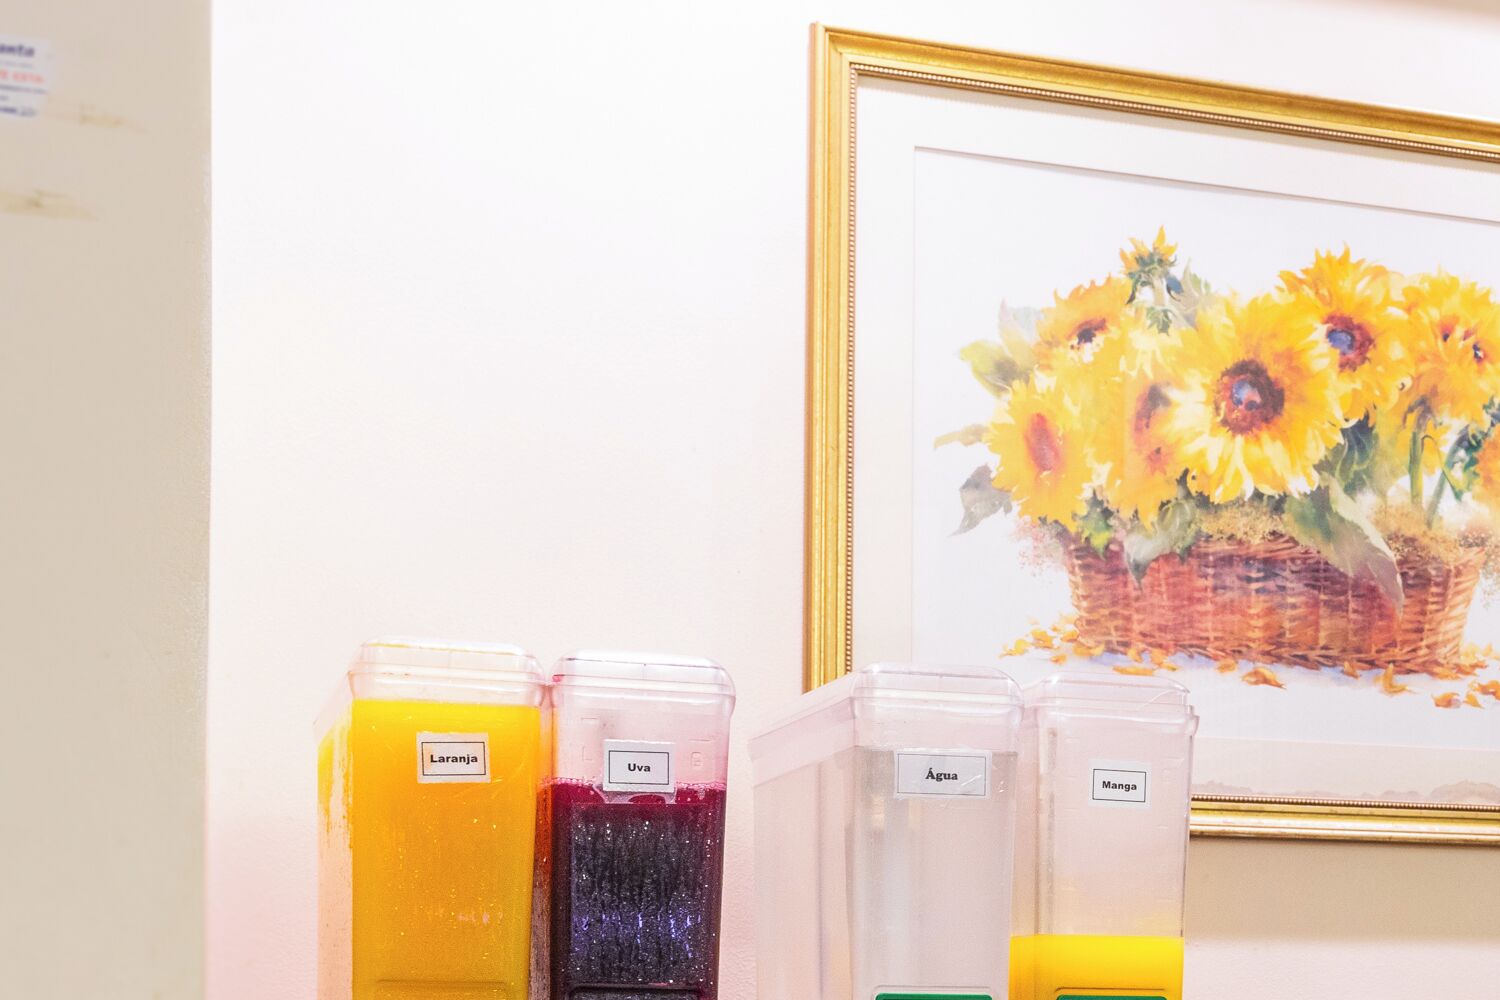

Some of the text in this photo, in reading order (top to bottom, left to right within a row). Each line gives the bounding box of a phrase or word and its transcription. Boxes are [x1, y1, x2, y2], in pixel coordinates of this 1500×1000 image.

[429, 754, 478, 766] Laranja
[627, 762, 651, 773] Uva
[925, 767, 958, 782] Água
[1101, 780, 1137, 792] Manga
